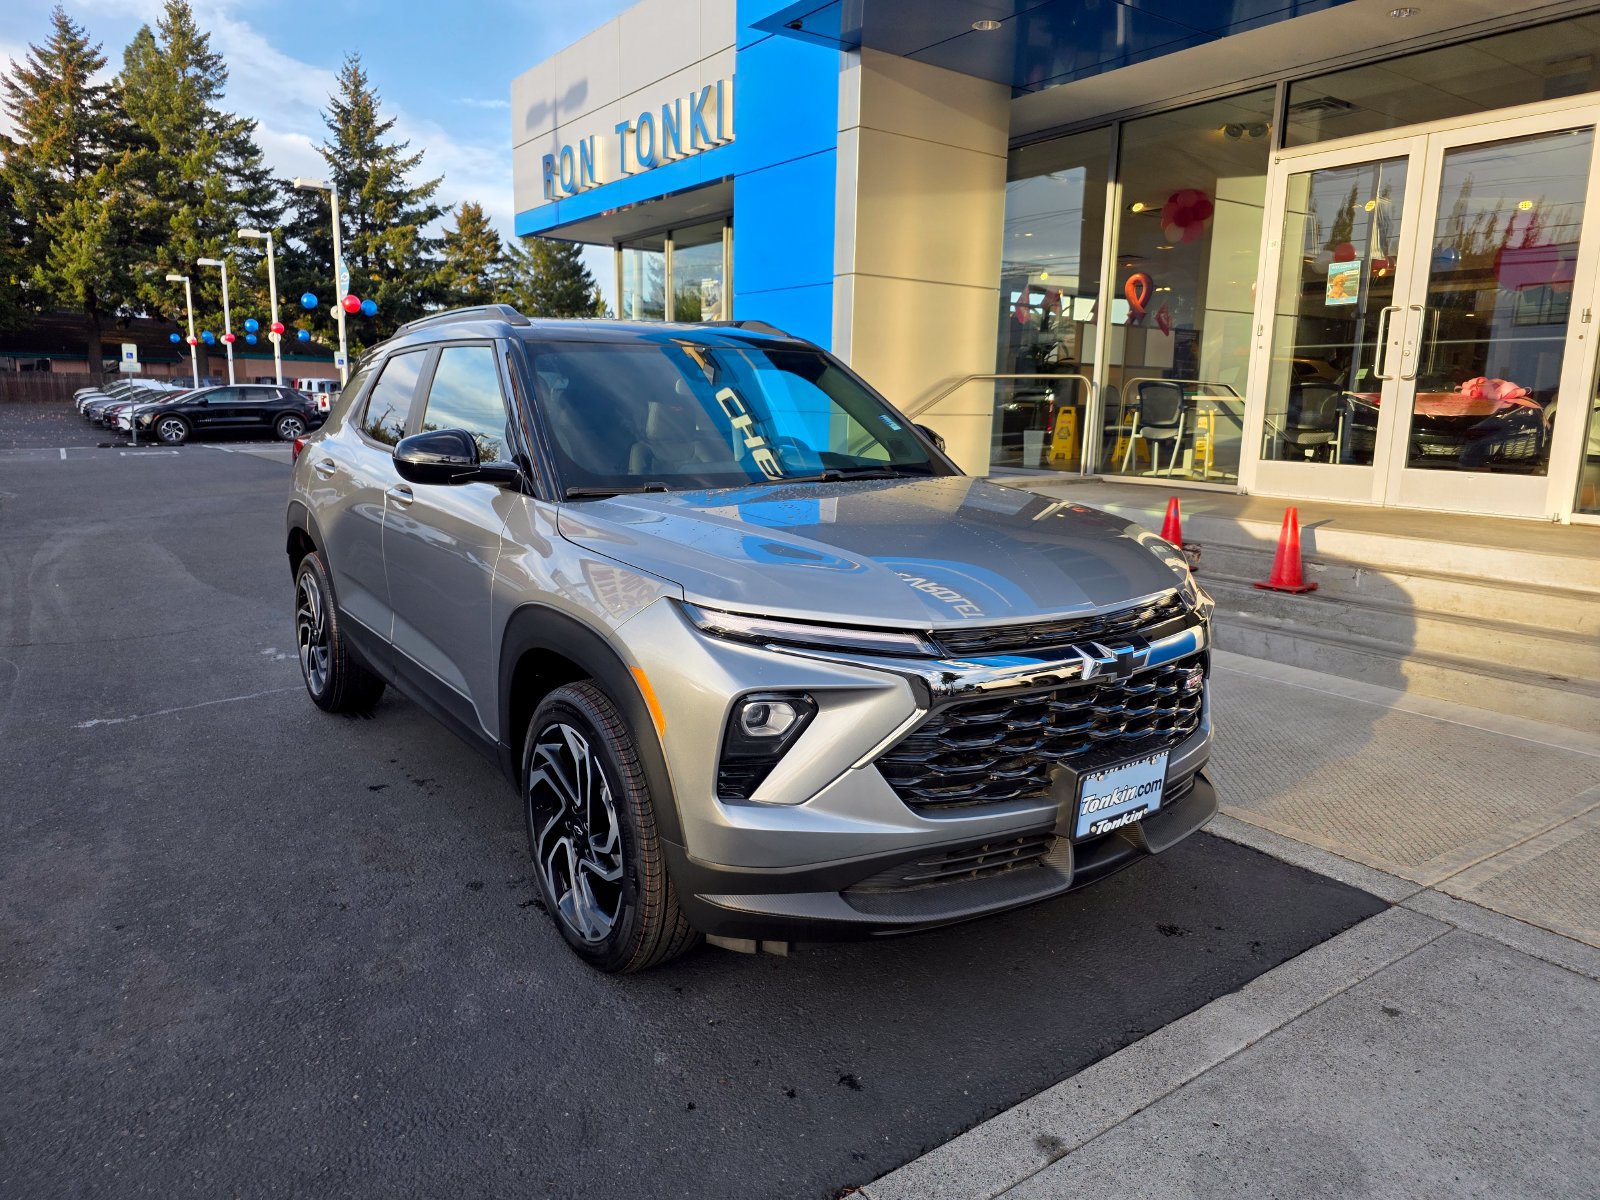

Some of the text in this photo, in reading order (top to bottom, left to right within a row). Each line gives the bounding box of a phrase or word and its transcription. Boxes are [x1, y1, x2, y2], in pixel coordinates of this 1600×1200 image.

[542, 75, 735, 201] RON TONKI
[1080, 778, 1162, 816] Tonkin.com
[1096, 810, 1143, 835] Tonkin
